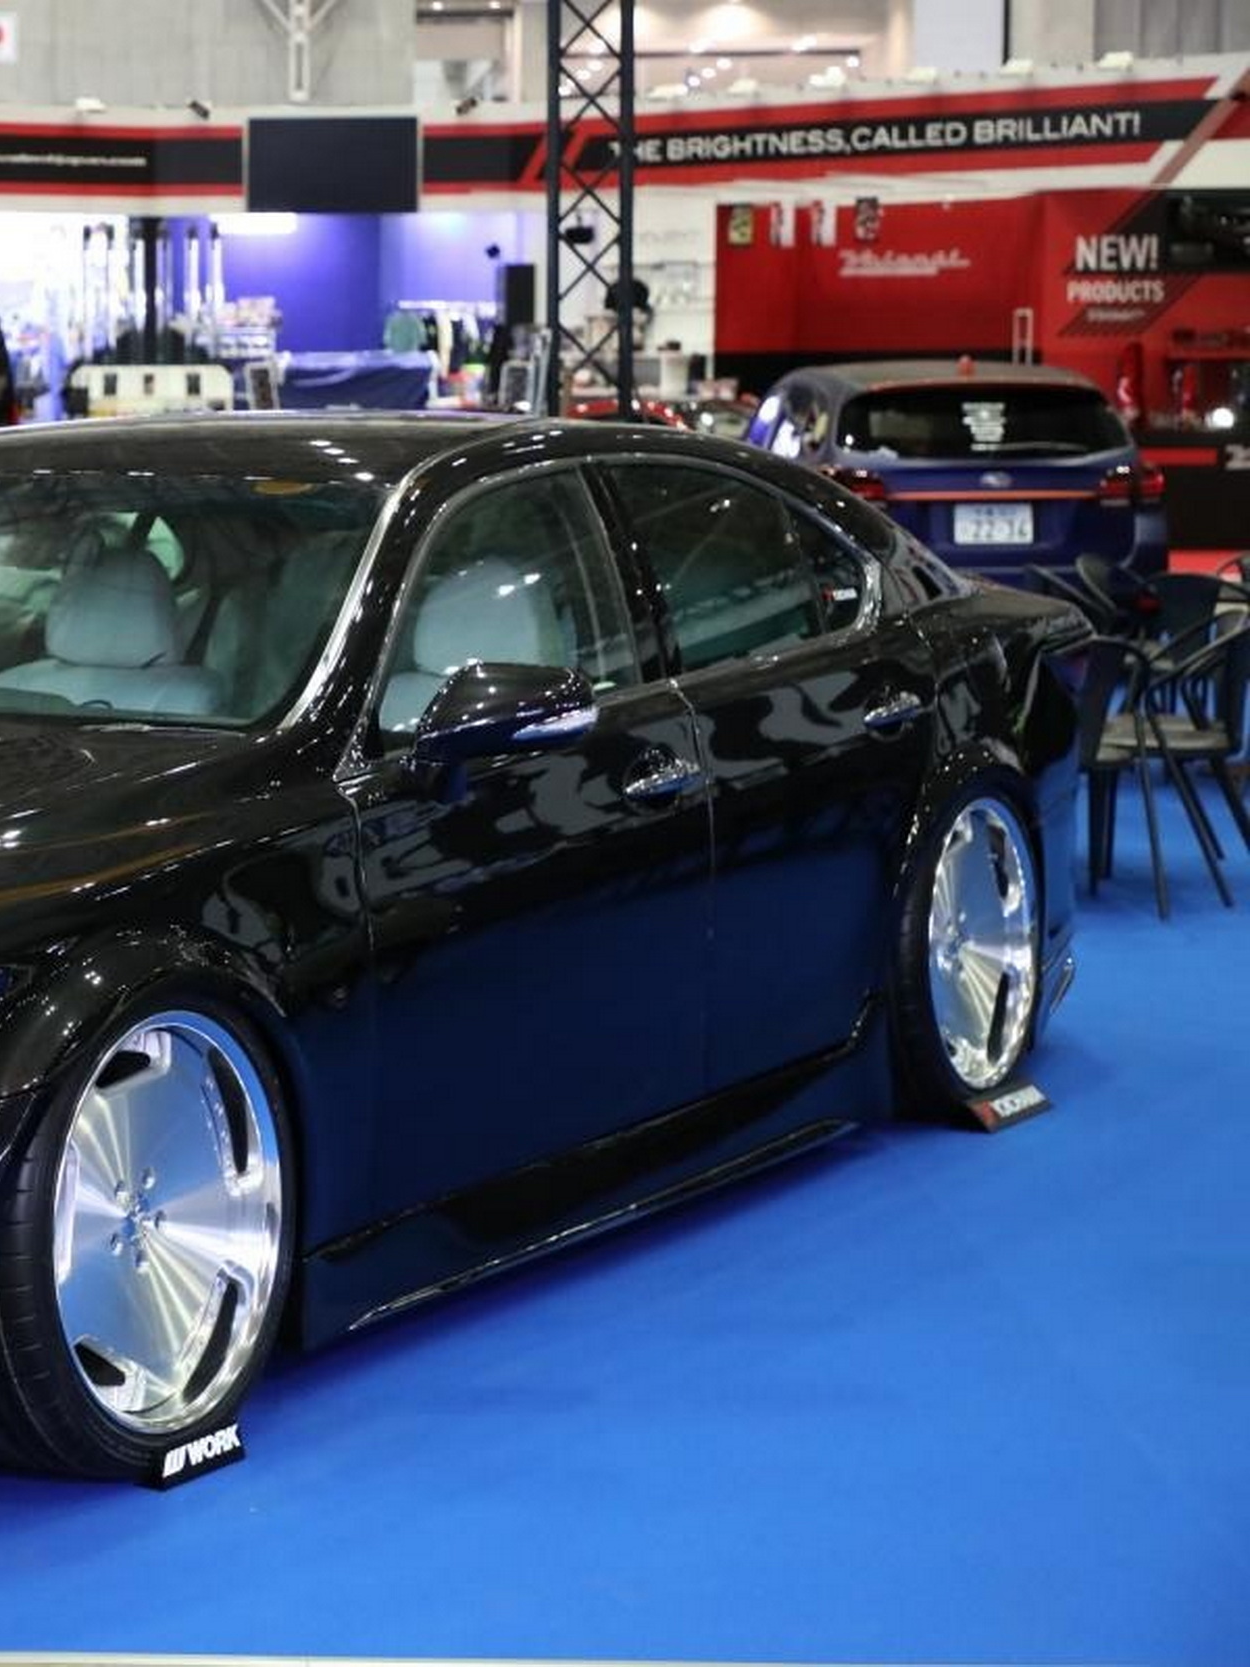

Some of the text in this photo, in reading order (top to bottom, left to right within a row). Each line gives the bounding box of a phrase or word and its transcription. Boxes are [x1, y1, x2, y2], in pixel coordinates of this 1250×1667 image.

[973, 111, 1141, 144] BRILLIANT!
[1075, 235, 1159, 271] NEW!
[1066, 280, 1164, 303] PRODUCTS
[186, 1423, 241, 1466] WORK
